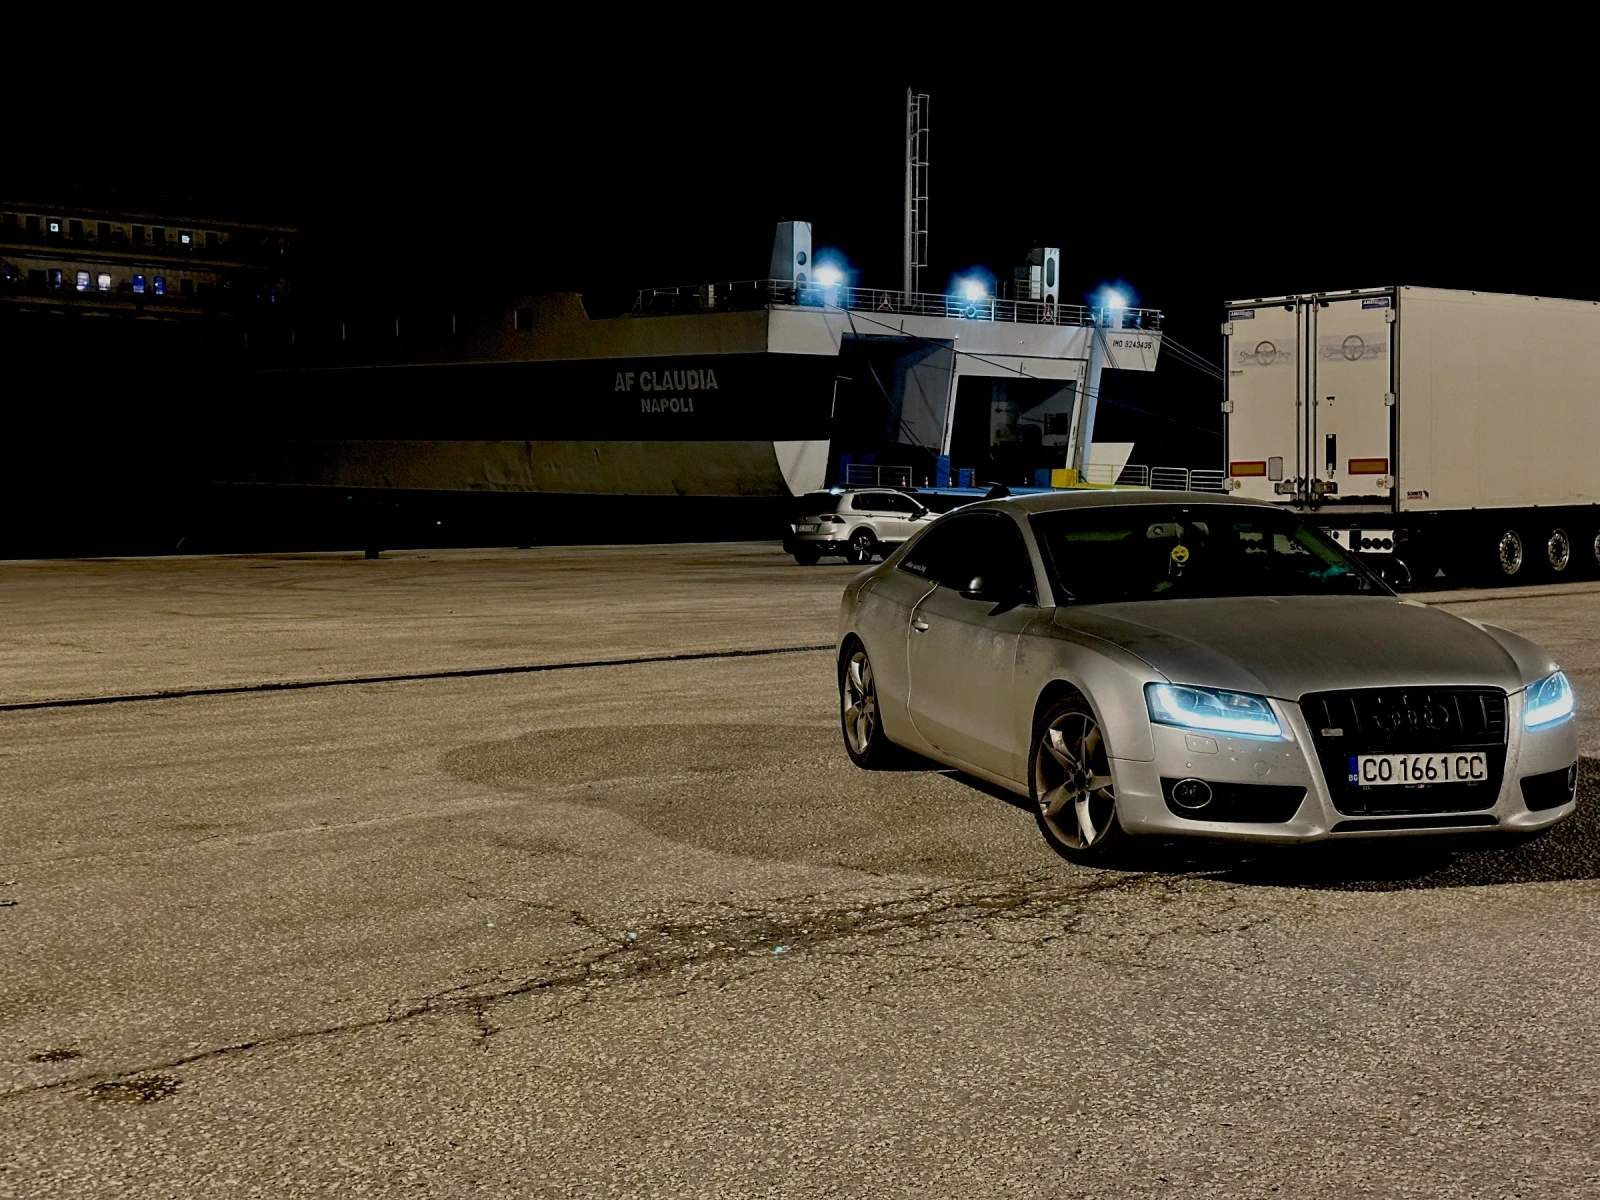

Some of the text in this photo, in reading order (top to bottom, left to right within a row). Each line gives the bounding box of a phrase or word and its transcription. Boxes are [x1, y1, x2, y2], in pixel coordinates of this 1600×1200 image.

[614, 369, 719, 392] AF CLAUDIA
[640, 397, 694, 413] NAPOLI
[1348, 756, 1483, 782] BG CO 1661 CC
